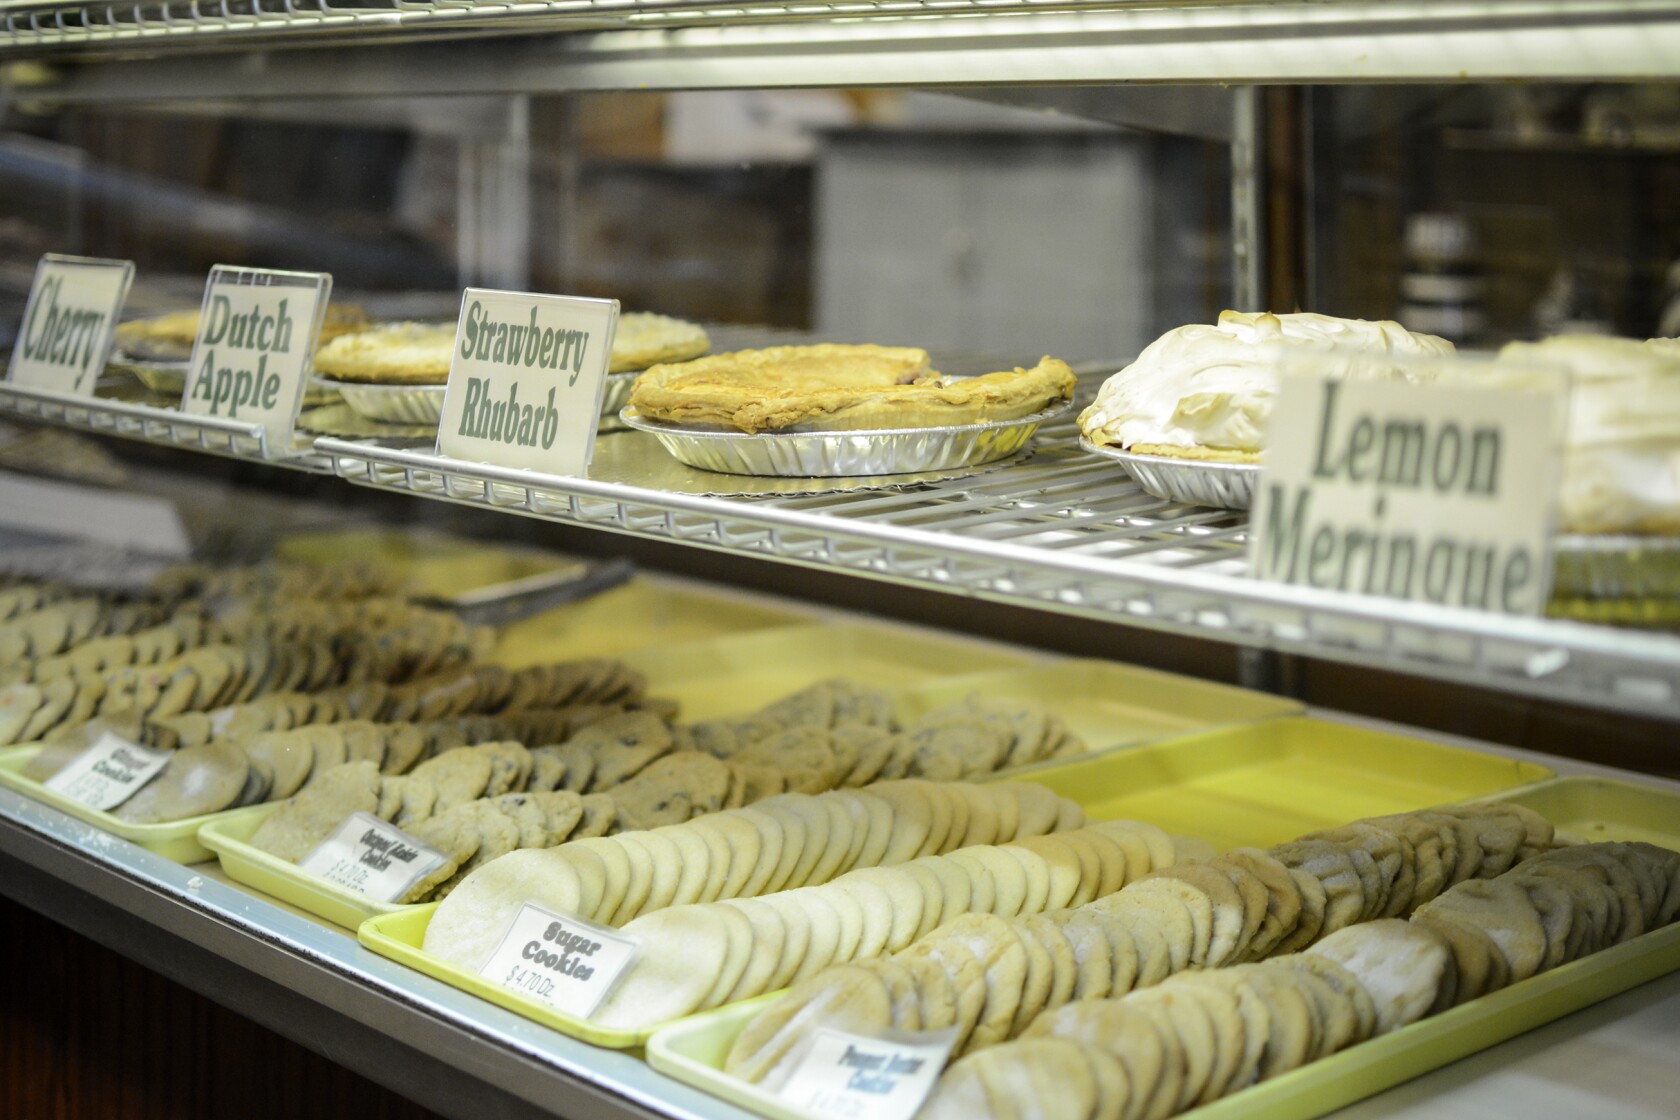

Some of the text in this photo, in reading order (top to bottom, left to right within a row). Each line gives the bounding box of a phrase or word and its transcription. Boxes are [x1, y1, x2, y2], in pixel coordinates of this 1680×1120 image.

[22, 274, 106, 390] Cherry
[203, 294, 293, 352] Dutch
[460, 300, 590, 388] Strawberry
[191, 350, 281, 418] Apple
[457, 376, 559, 451] Rhubarb
[1311, 380, 1502, 497] Lemon
[521, 940, 595, 982] Cookies
[542, 921, 602, 957] Sugar
